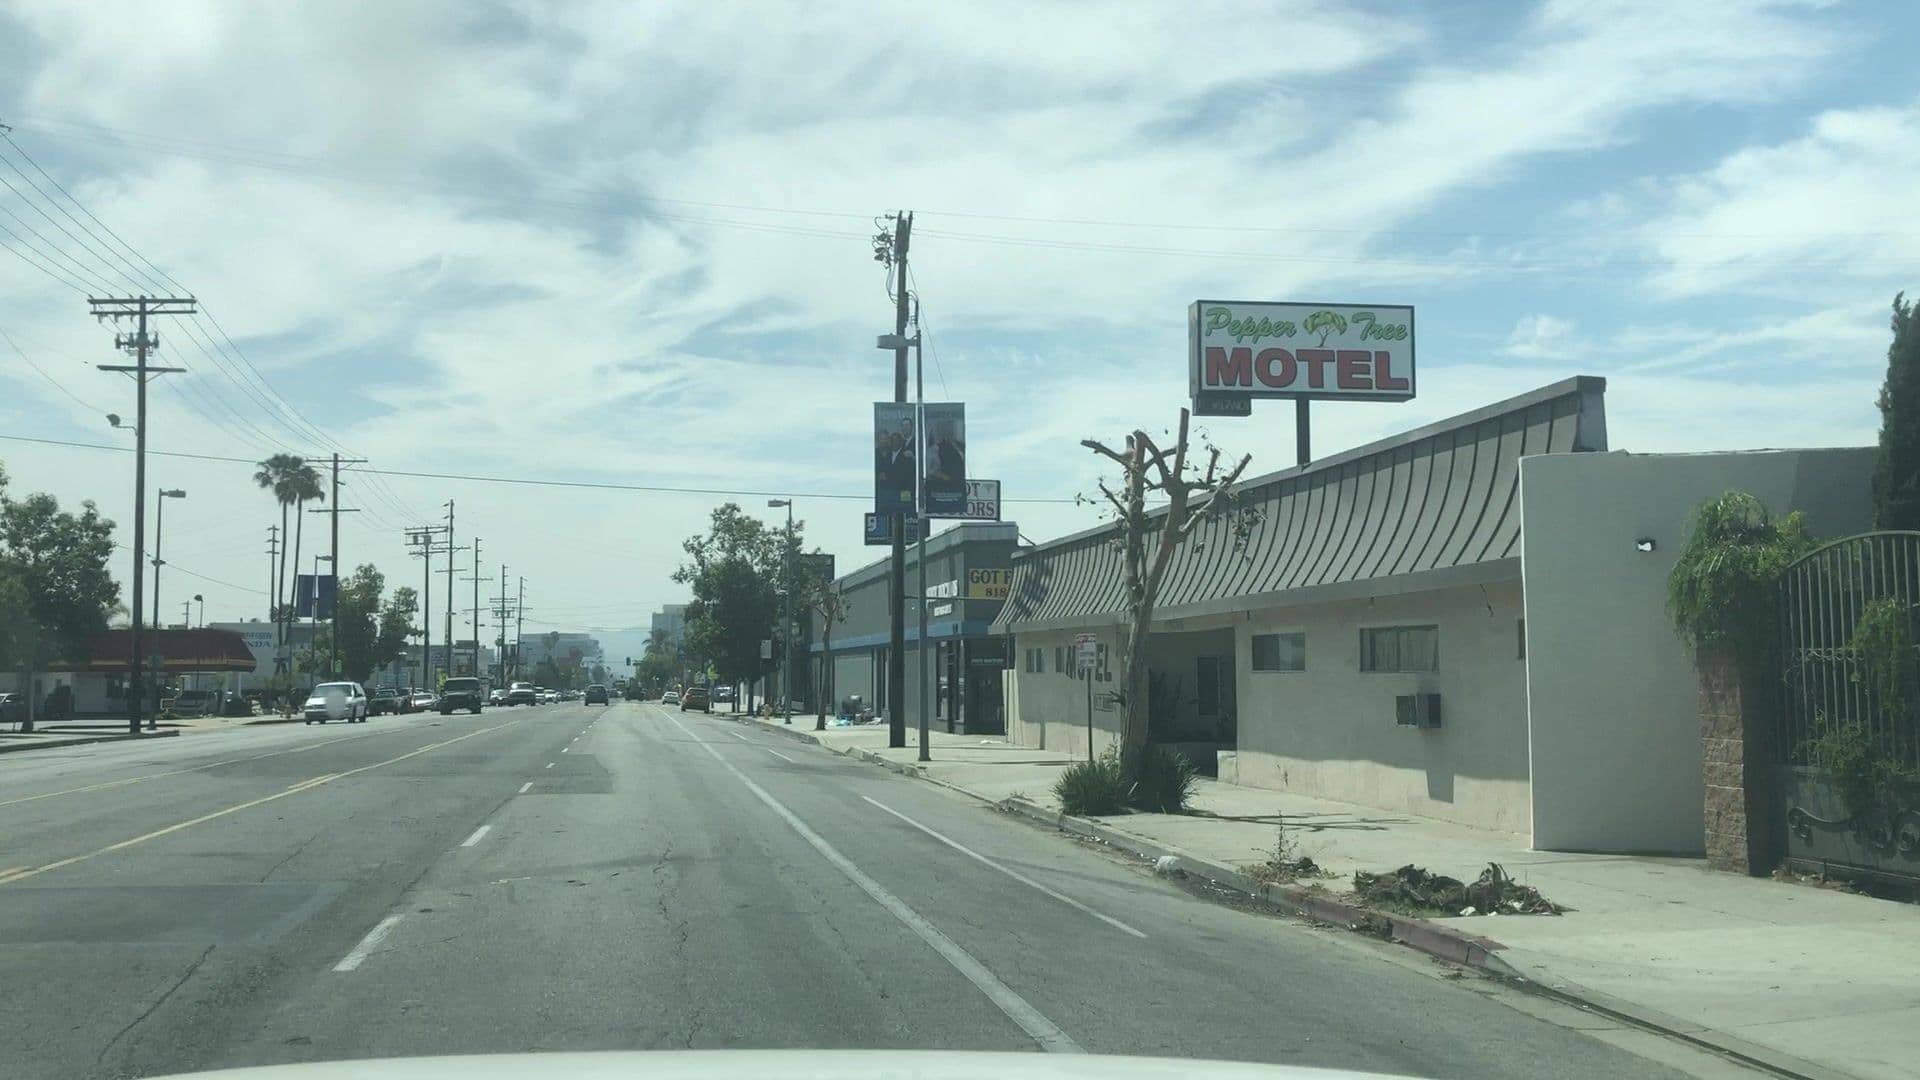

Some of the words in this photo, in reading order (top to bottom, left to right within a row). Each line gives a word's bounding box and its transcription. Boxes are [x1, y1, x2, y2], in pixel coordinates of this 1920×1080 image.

[1205, 307, 1296, 343] Pepper
[1351, 311, 1408, 341] Tree
[1205, 347, 1409, 390] MOTEL
[970, 569, 998, 584] GOT
